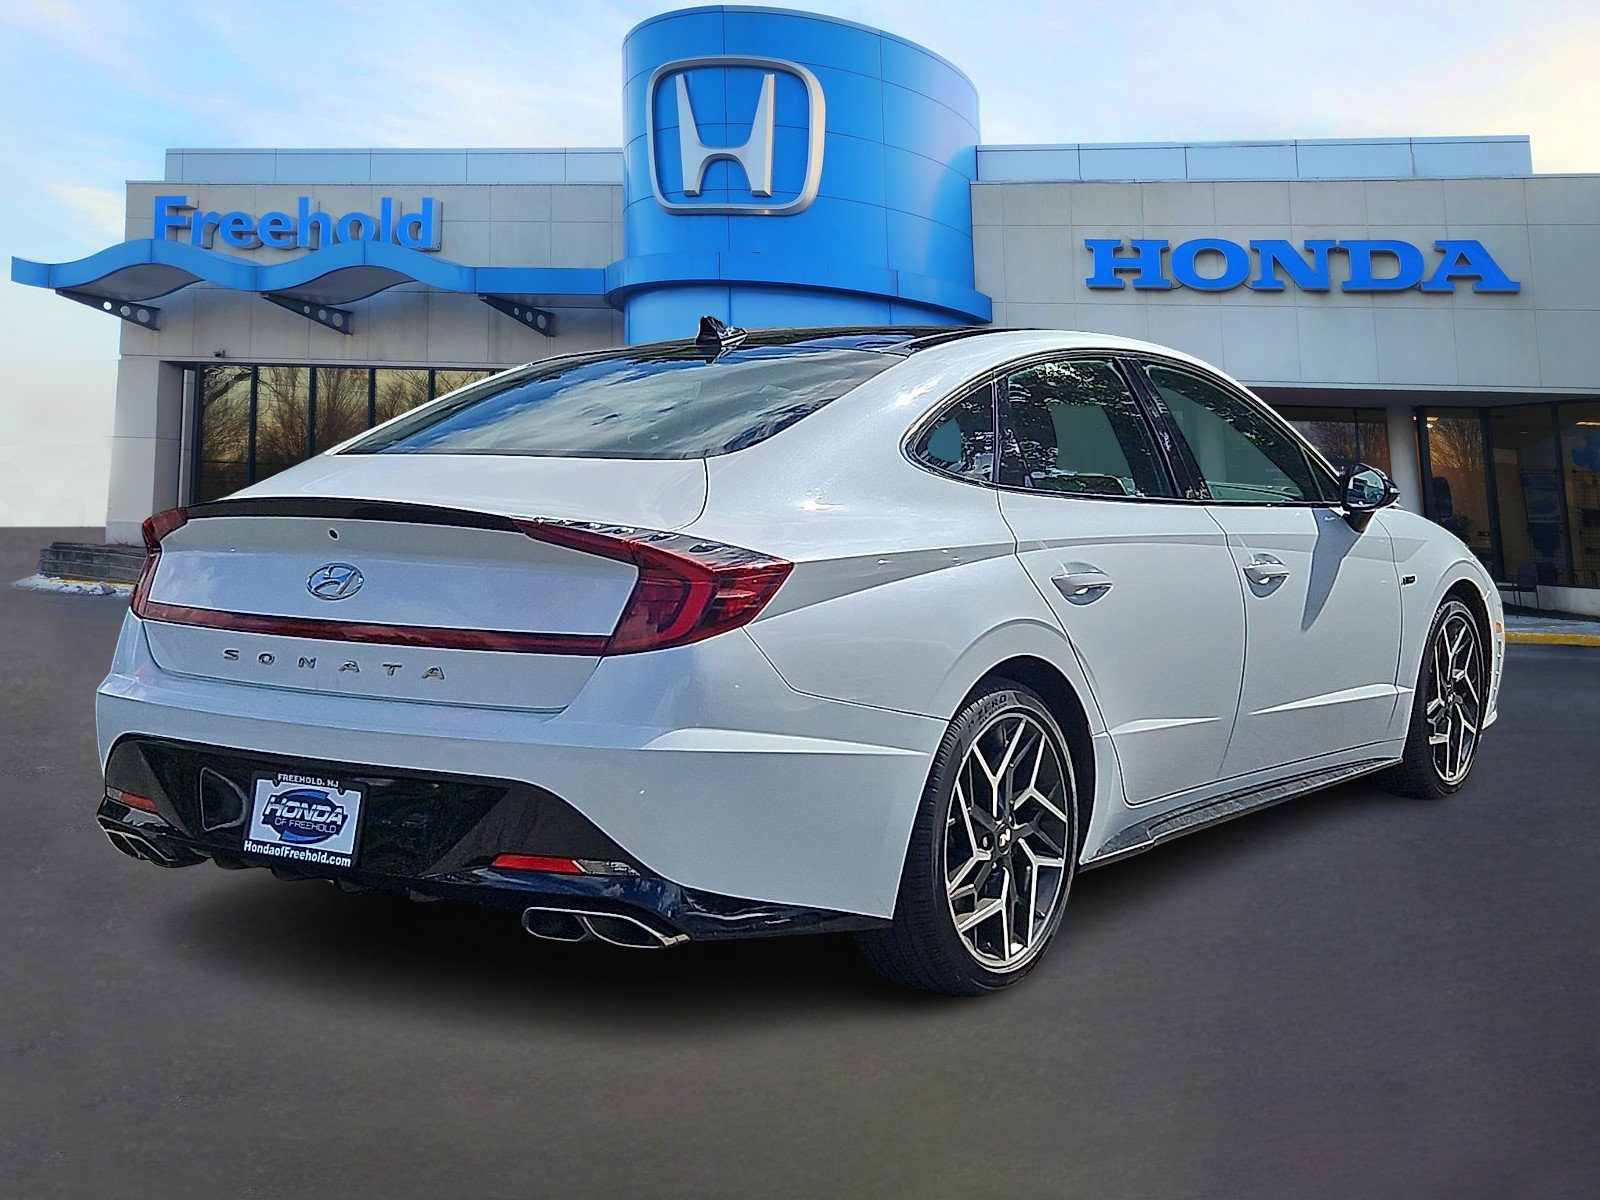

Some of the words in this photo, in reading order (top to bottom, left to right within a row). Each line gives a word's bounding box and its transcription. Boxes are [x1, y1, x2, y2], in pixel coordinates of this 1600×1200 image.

[153, 195, 441, 251] Freehold
[1084, 238, 1522, 293] HONDA
[223, 648, 445, 681] SONATA
[326, 780, 340, 788] NJ
[264, 796, 344, 825] HONDA
[274, 816, 287, 827] OF
[288, 818, 337, 834] FREEHOLD
[243, 840, 352, 868] HondaofFreehold.com
